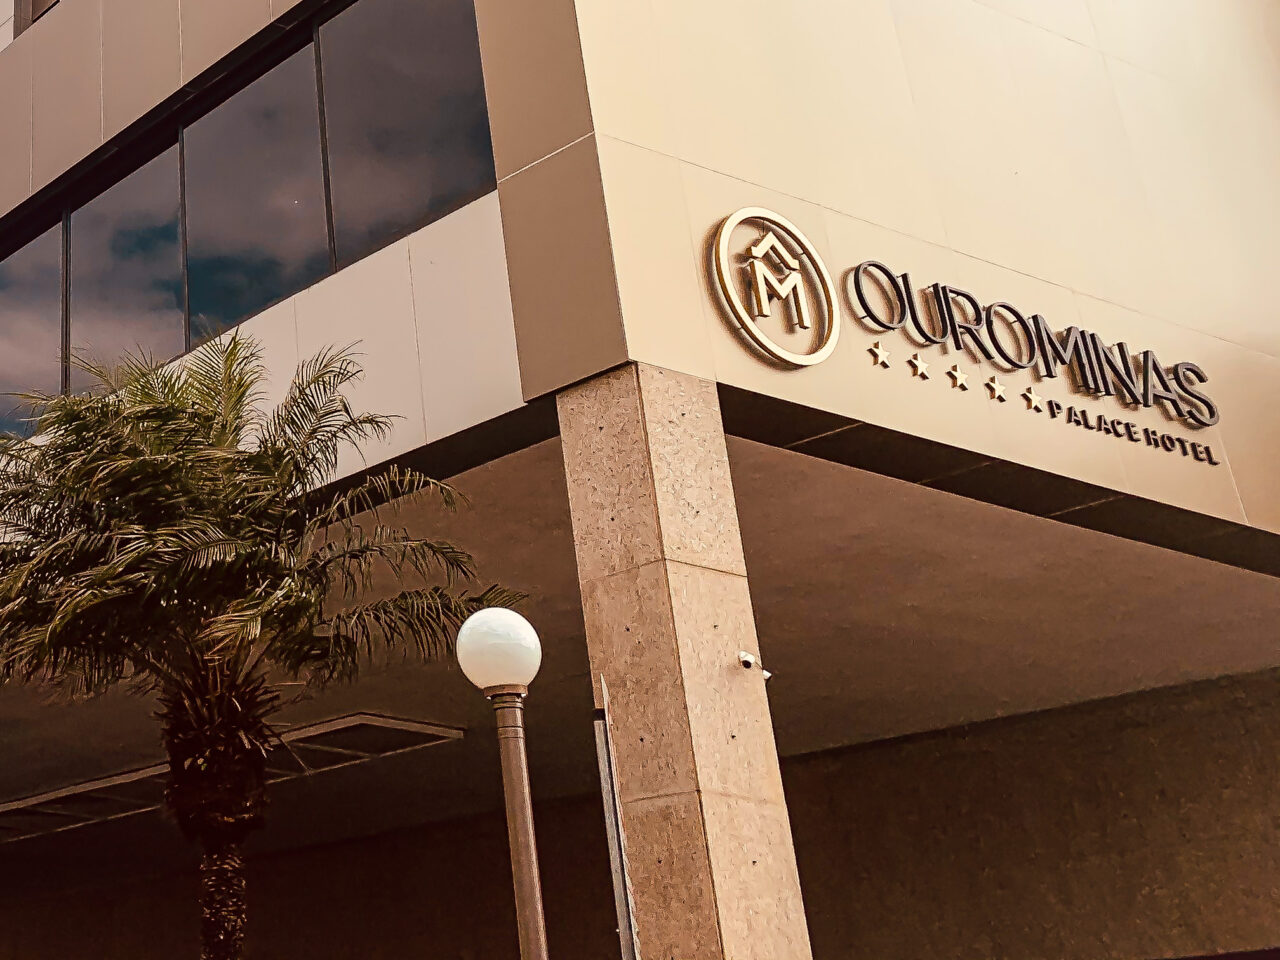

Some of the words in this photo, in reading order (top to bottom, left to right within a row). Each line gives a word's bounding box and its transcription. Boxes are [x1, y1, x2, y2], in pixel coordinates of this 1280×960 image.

[853, 260, 1220, 427] OUROMINAS
[1046, 399, 1141, 443] PALACE
[1142, 428, 1220, 466] HOTEL
